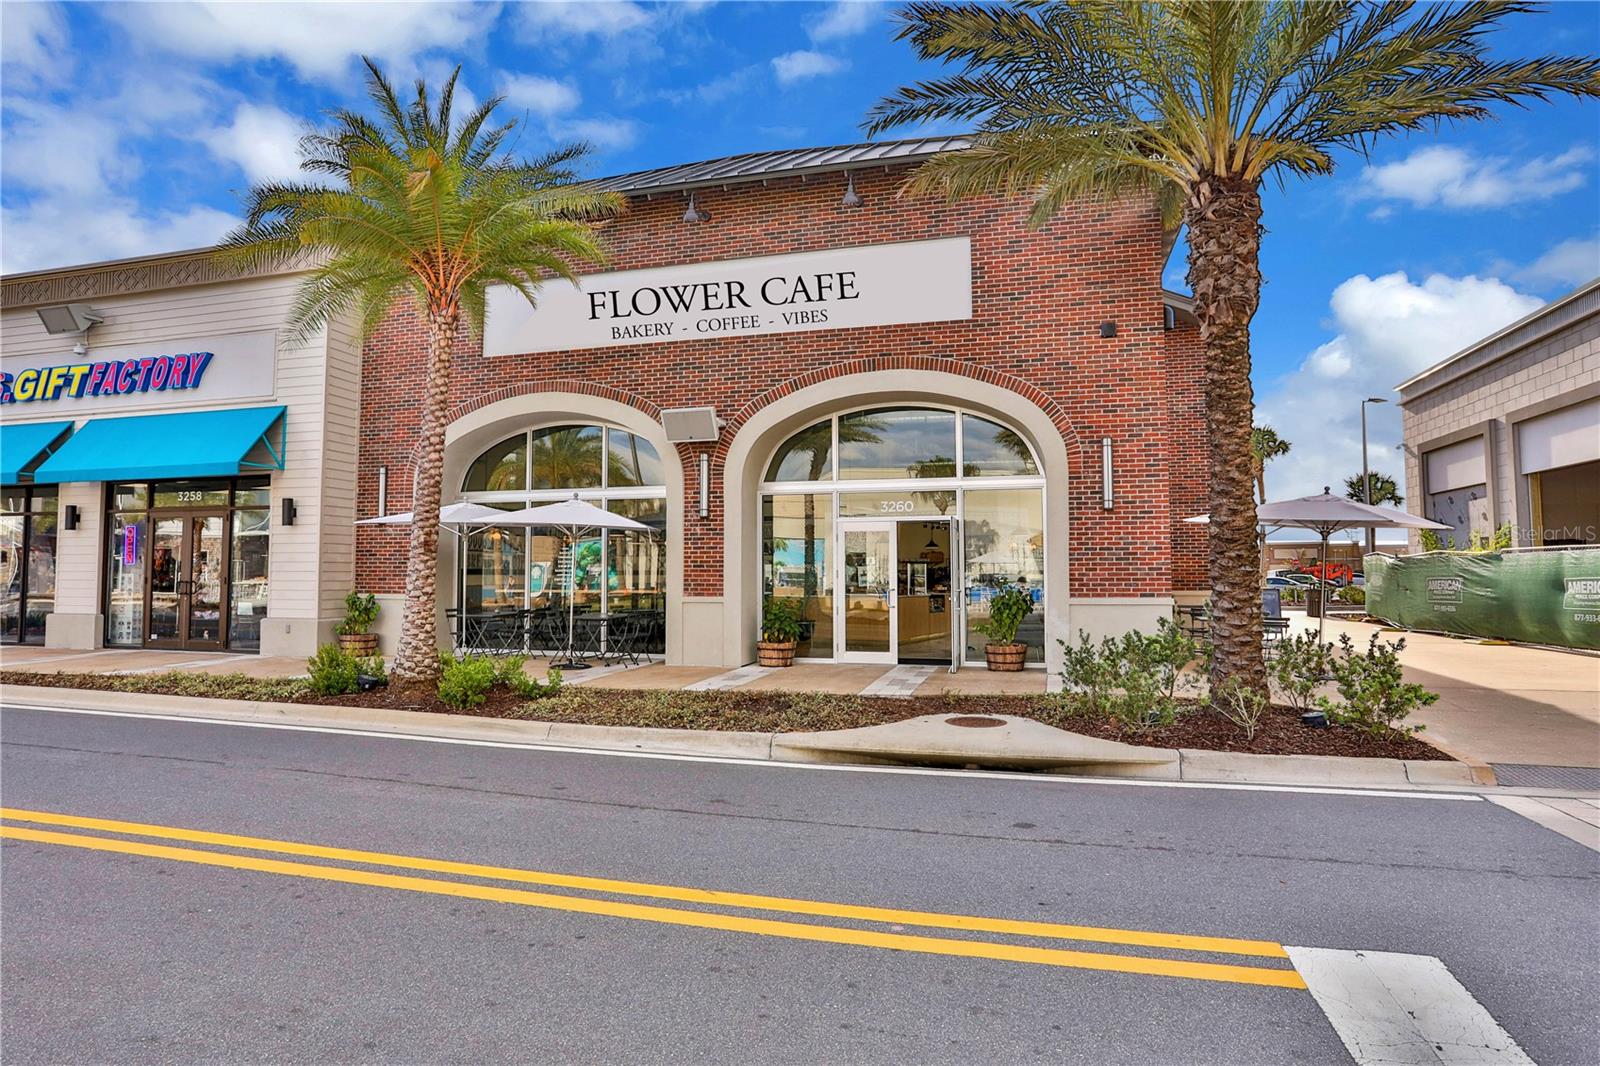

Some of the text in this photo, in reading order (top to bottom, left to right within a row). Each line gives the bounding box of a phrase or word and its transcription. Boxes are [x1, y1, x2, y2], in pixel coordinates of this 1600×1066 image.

[587, 271, 860, 320] FLOWER CAFE
[611, 322, 674, 340] BAKERY
[696, 315, 760, 333] COFFEE
[782, 309, 828, 326] VIBES
[177, 491, 202, 501] 3258
[880, 500, 914, 513] 3260
[126, 527, 134, 563] OPEN
